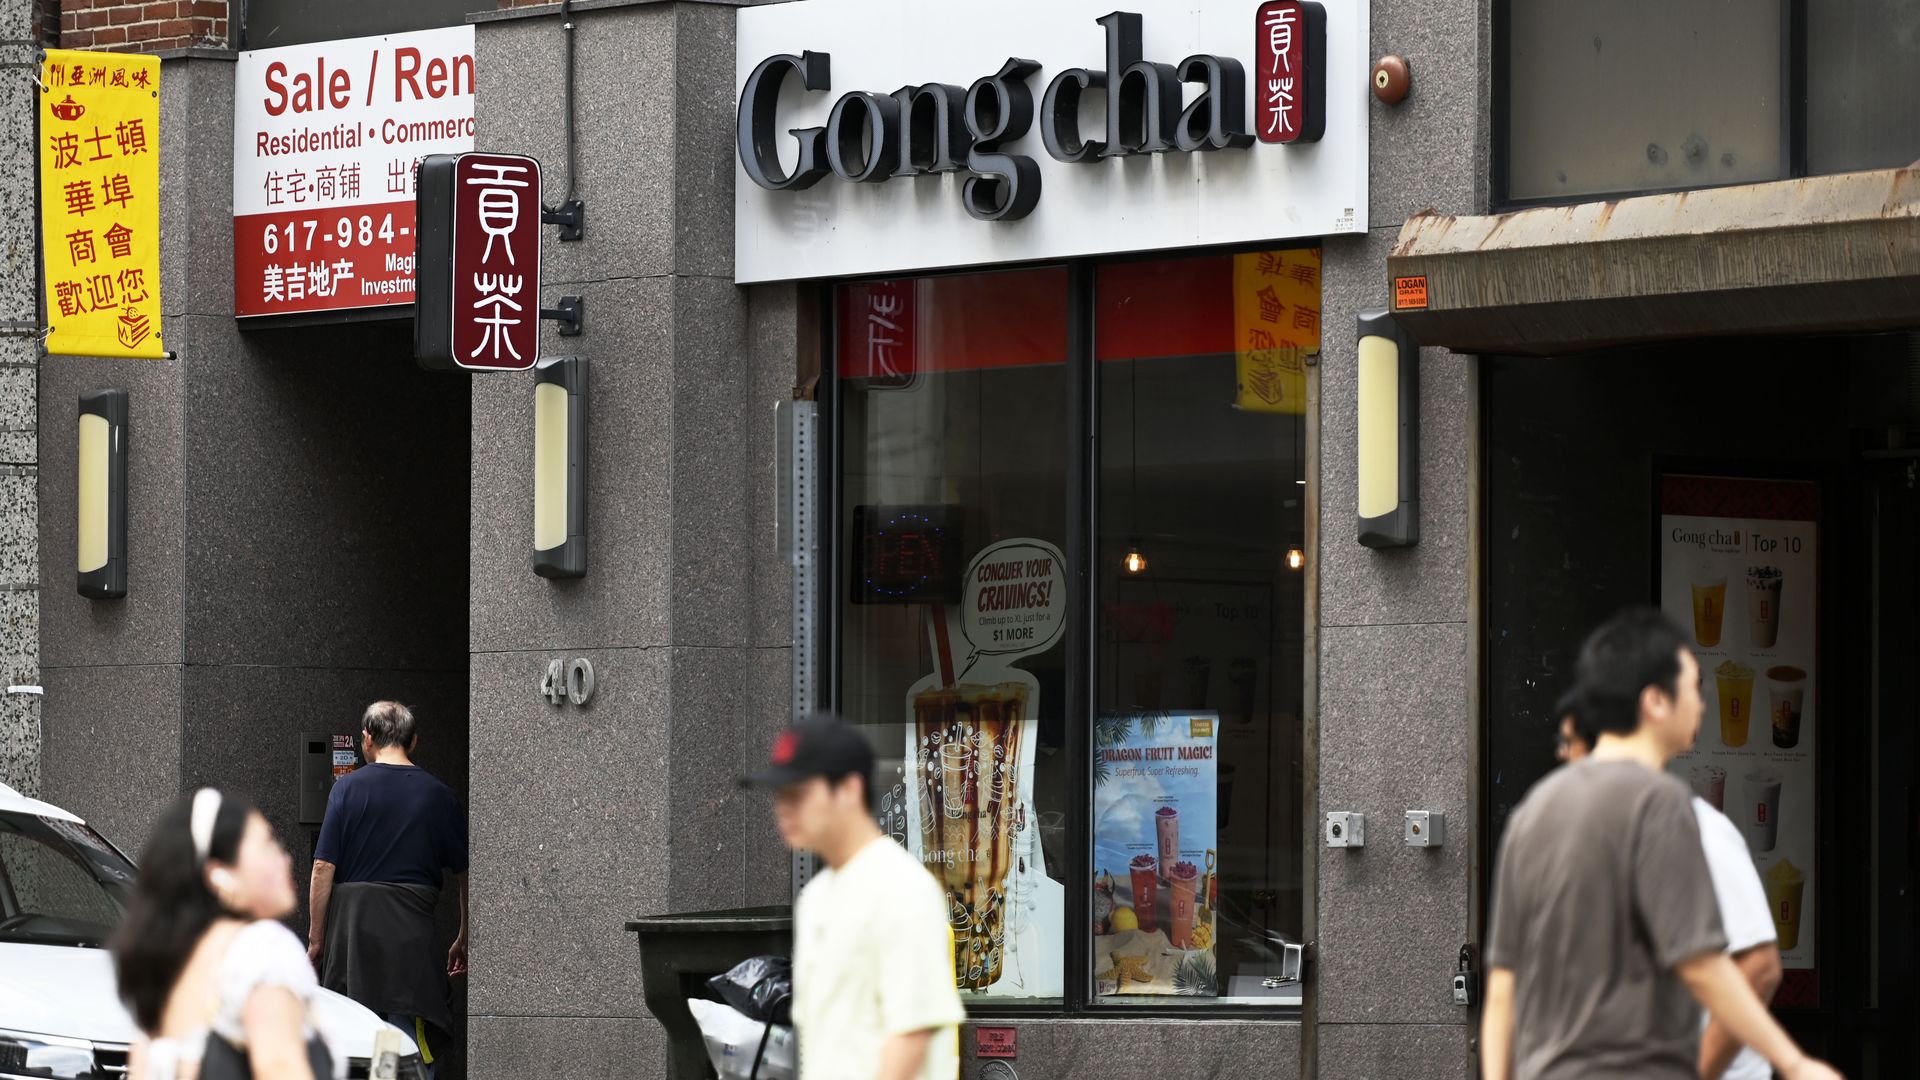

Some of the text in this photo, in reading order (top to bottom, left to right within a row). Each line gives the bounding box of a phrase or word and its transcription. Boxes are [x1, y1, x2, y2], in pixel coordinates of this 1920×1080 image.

[68, 65, 152, 89] 亞洲風味
[263, 47, 475, 117] Sale / Ren
[1264, 8, 1297, 134] 貢茶
[737, 11, 1256, 220] Gong cha
[50, 118, 148, 169] 波士頓
[256, 117, 475, 158] Residential Commerc
[64, 173, 135, 217] 華埠
[66, 222, 134, 267] 商會
[263, 213, 417, 254] 617-984-
[263, 258, 355, 303] 美吉地产
[466, 163, 529, 361] 貢茶
[54, 268, 149, 317] 歡迎您
[1397, 279, 1425, 289] LOGAN
[1672, 528, 1706, 548] Gong
[1708, 529, 1732, 545] cha
[1784, 536, 1801, 553] 10
[977, 559, 1053, 582] CONQUER YOUR
[977, 580, 1053, 612] CRAVINGS!
[979, 616, 996, 626] Climb
[997, 617, 1007, 627] up
[1007, 616, 1014, 624] to
[1015, 614, 1022, 623] XL
[1023, 613, 1035, 624] just
[1036, 611, 1045, 621] for
[993, 627, 1034, 642] $1 MORE
[541, 657, 594, 705] 40
[1101, 745, 1213, 762] DRAGON FRUIT MAGIC!
[1147, 766, 1164, 777] Super
[1165, 765, 1200, 778] Refreshing.
